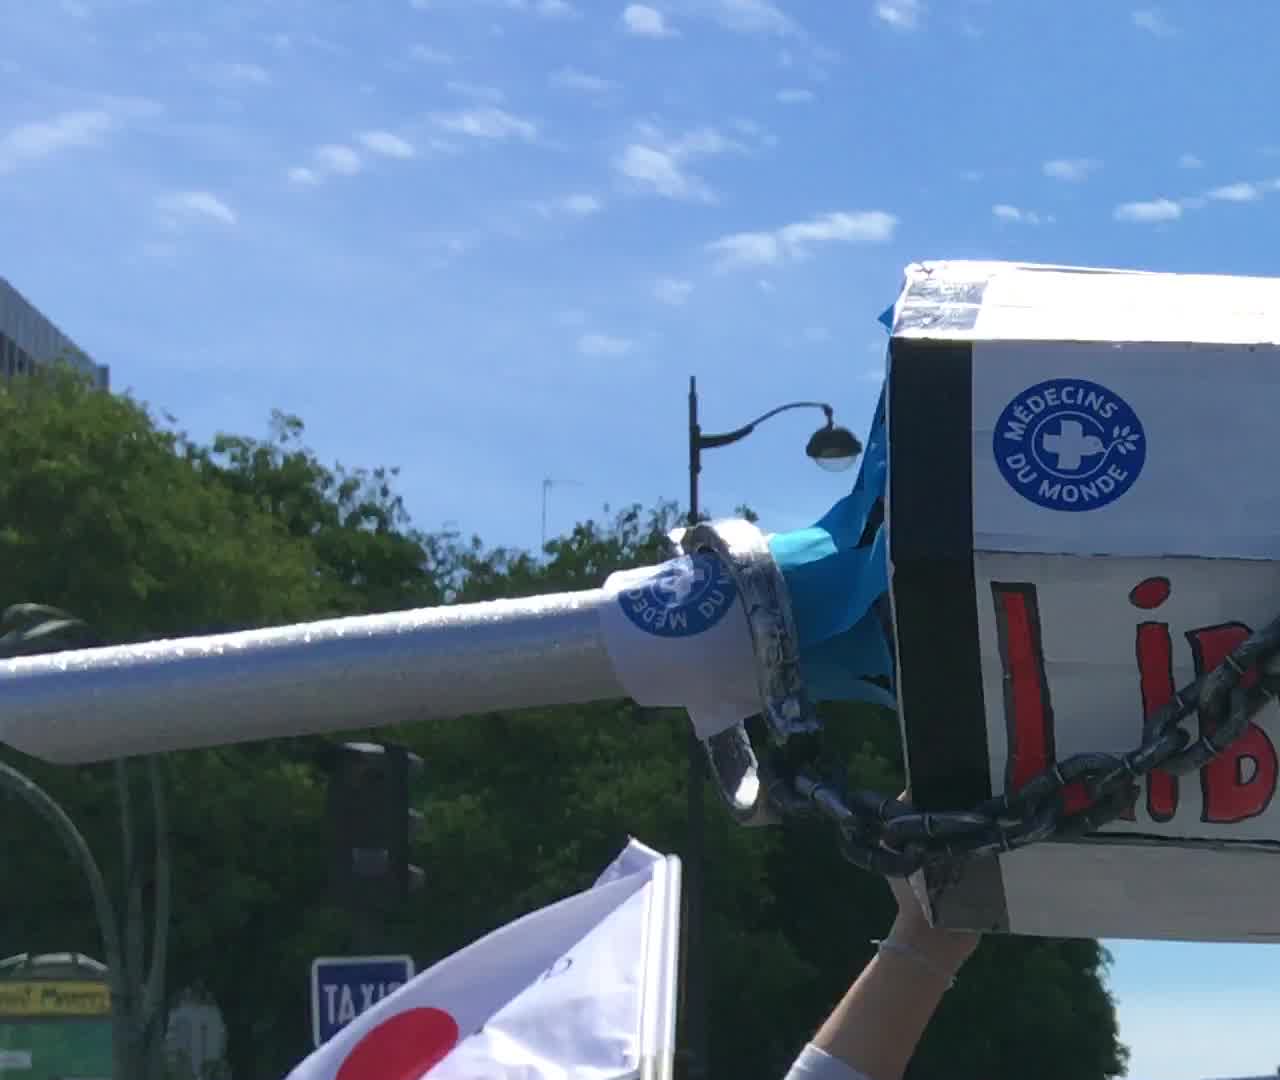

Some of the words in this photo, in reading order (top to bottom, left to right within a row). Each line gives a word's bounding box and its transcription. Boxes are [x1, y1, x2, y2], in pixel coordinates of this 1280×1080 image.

[1003, 386, 1119, 441] MÉDECINS
[1006, 453, 1037, 484] DU
[1038, 464, 1129, 502] MONDE
